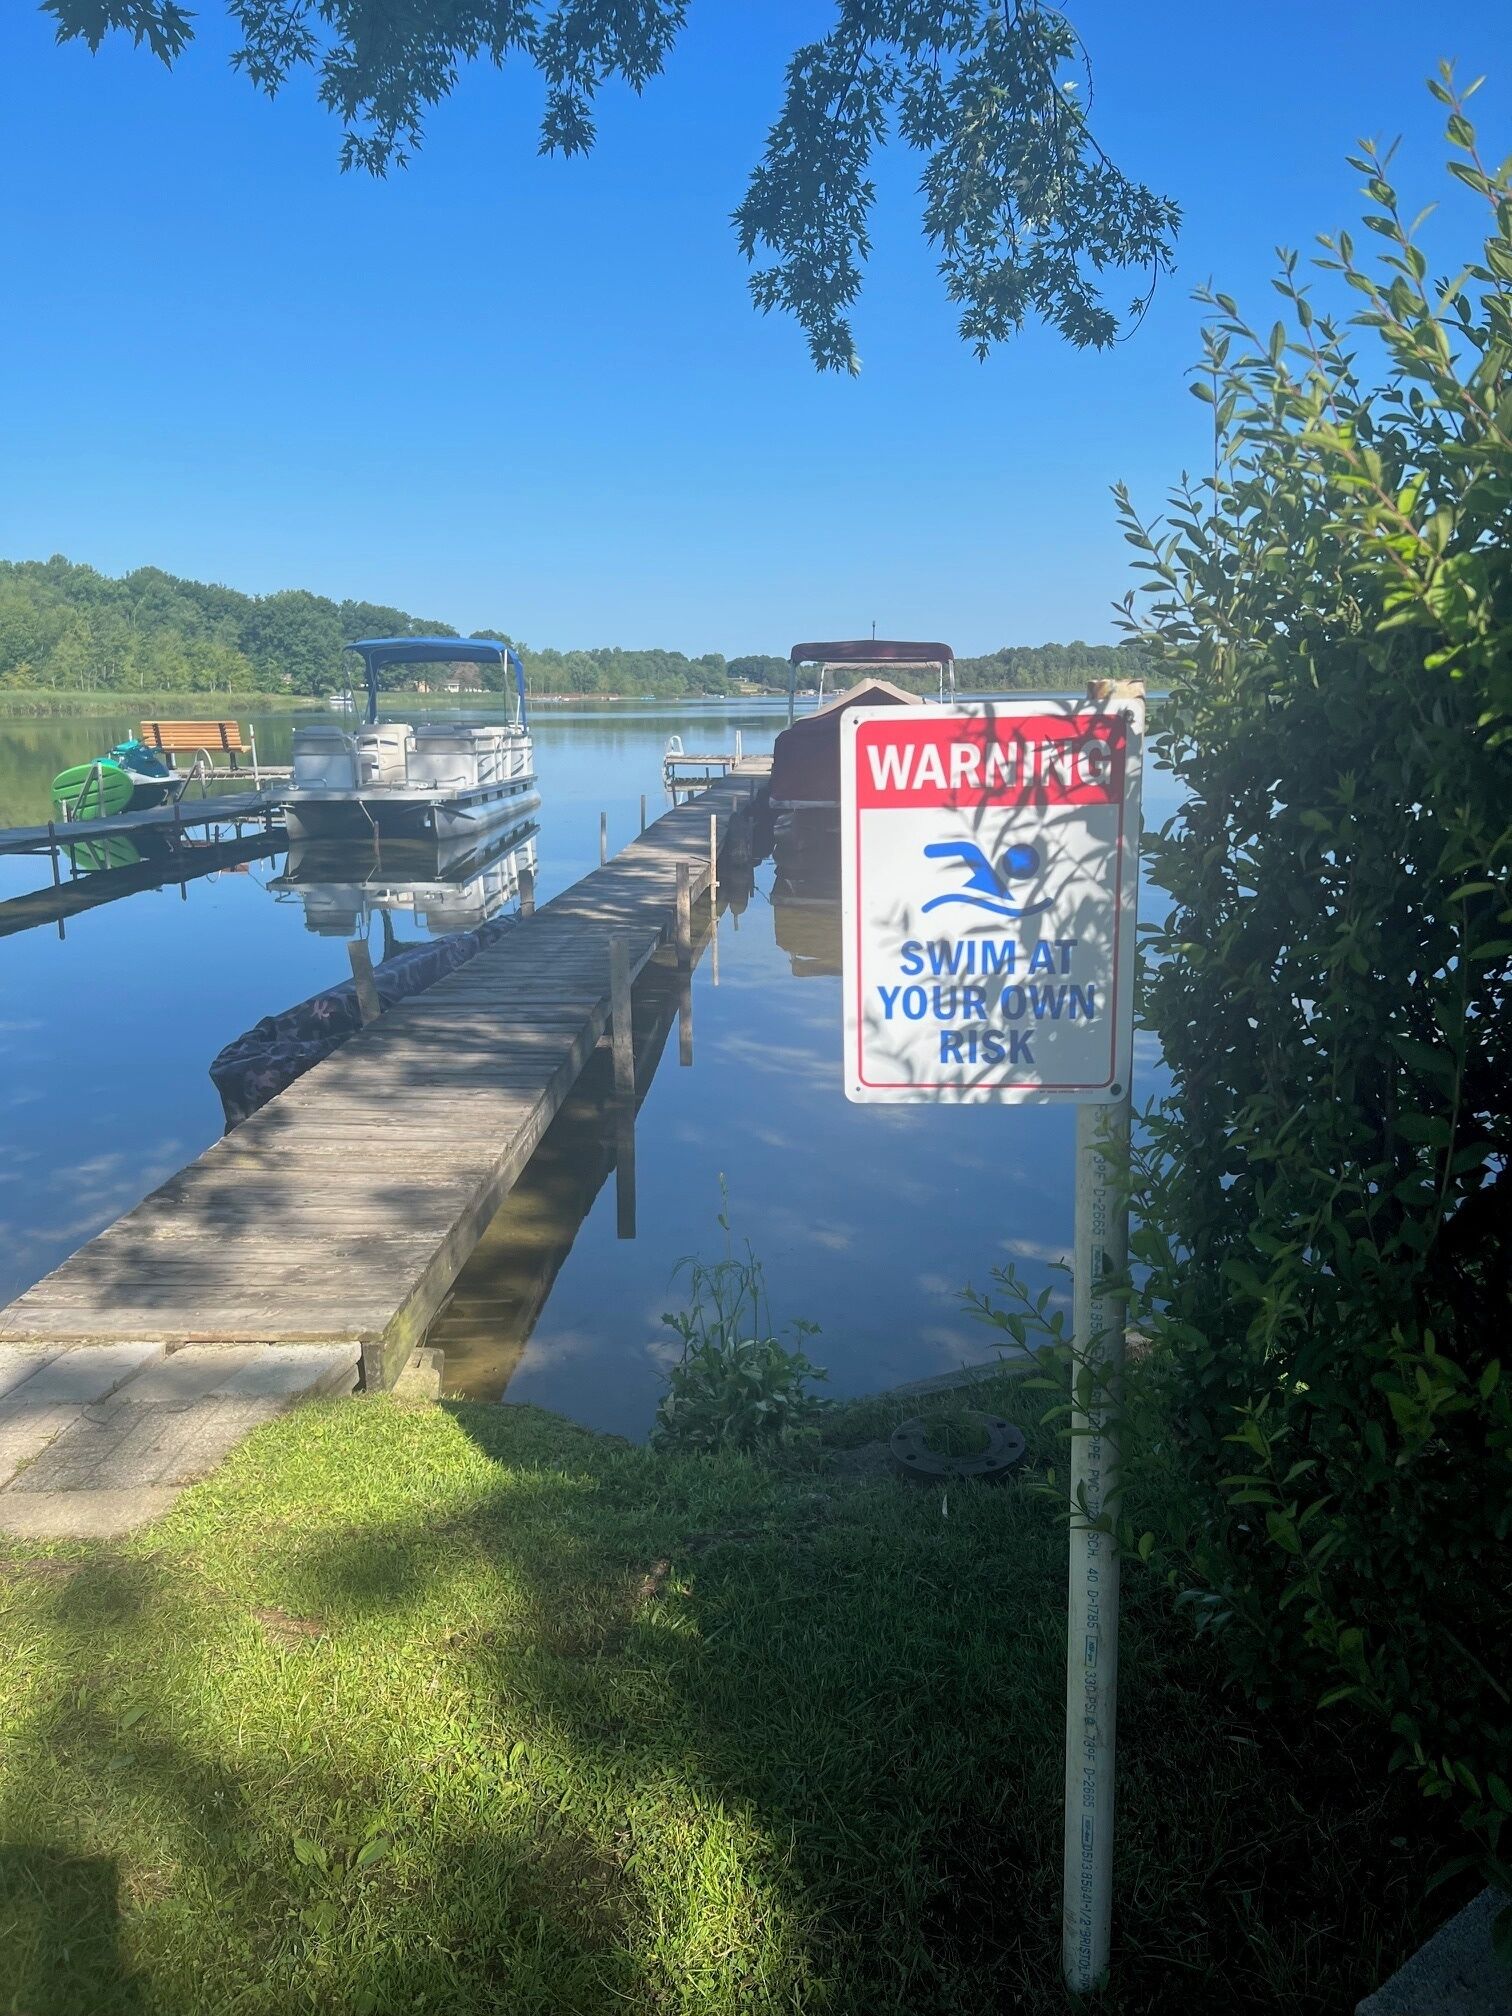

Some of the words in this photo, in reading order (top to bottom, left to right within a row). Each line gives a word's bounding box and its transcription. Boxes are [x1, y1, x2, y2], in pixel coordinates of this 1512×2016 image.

[866, 738, 1112, 791] WARNING
[899, 939, 1016, 976] SWIM
[1029, 939, 1078, 975] AT
[877, 985, 988, 1020] YOUR
[1001, 984, 1095, 1020] OWN
[939, 1029, 1036, 1064] RISK
[1093, 1188, 1106, 1236] D-2665
[1088, 1469, 1100, 1493] PVC
[1087, 1532, 1099, 1559] SCH.
[1087, 1568, 1099, 1583] 40
[1087, 1590, 1099, 1629] D-1785
[1085, 1670, 1097, 1692] 330
[1083, 1767, 1096, 1809] D-2665
